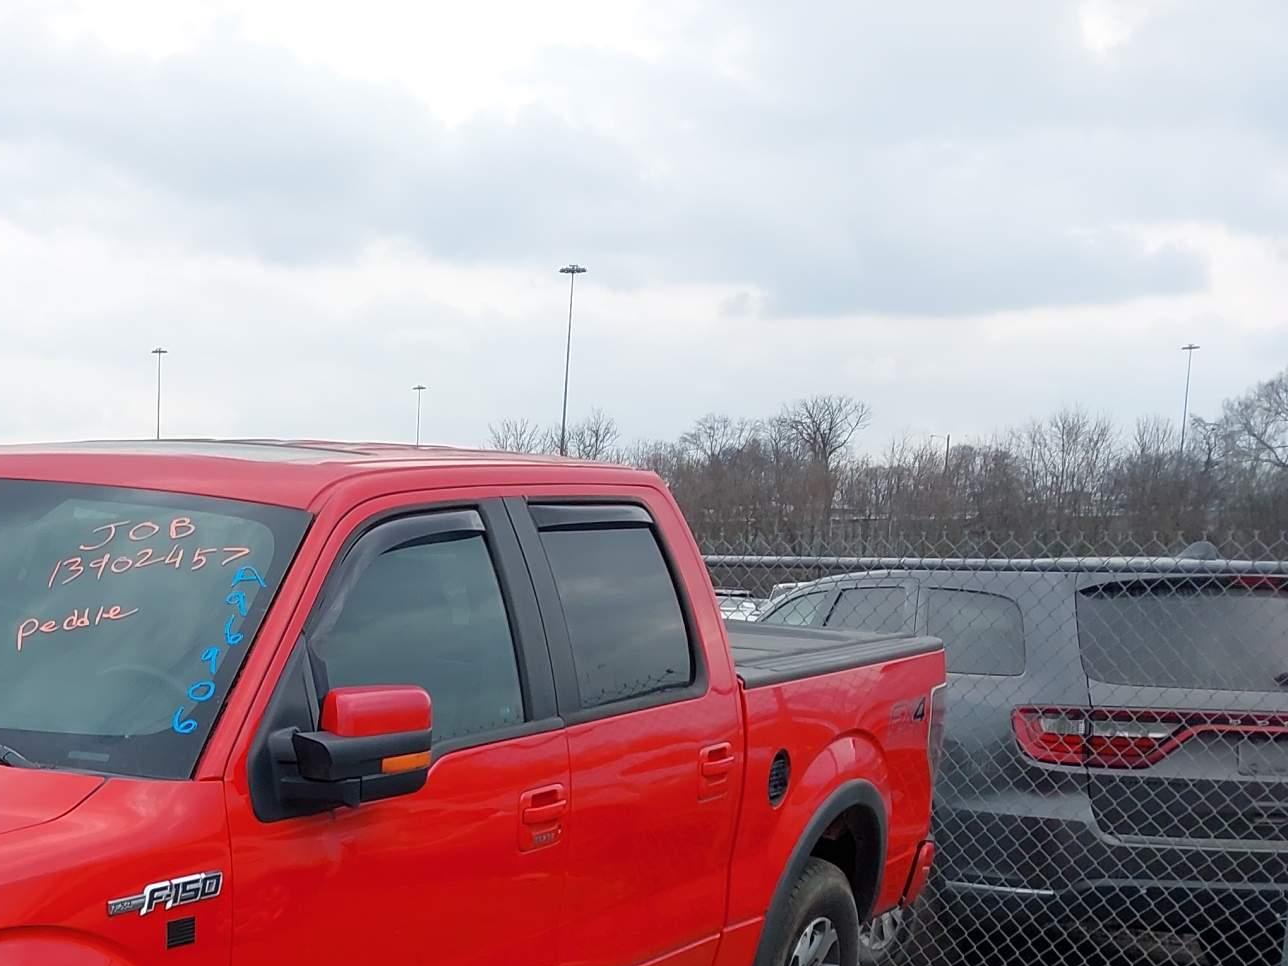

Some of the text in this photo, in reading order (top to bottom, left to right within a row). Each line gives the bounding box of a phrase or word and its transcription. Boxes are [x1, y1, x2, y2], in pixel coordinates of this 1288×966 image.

[79, 517, 196, 551] JOB
[47, 545, 251, 590] 13902457
[17, 604, 140, 651] peddle
